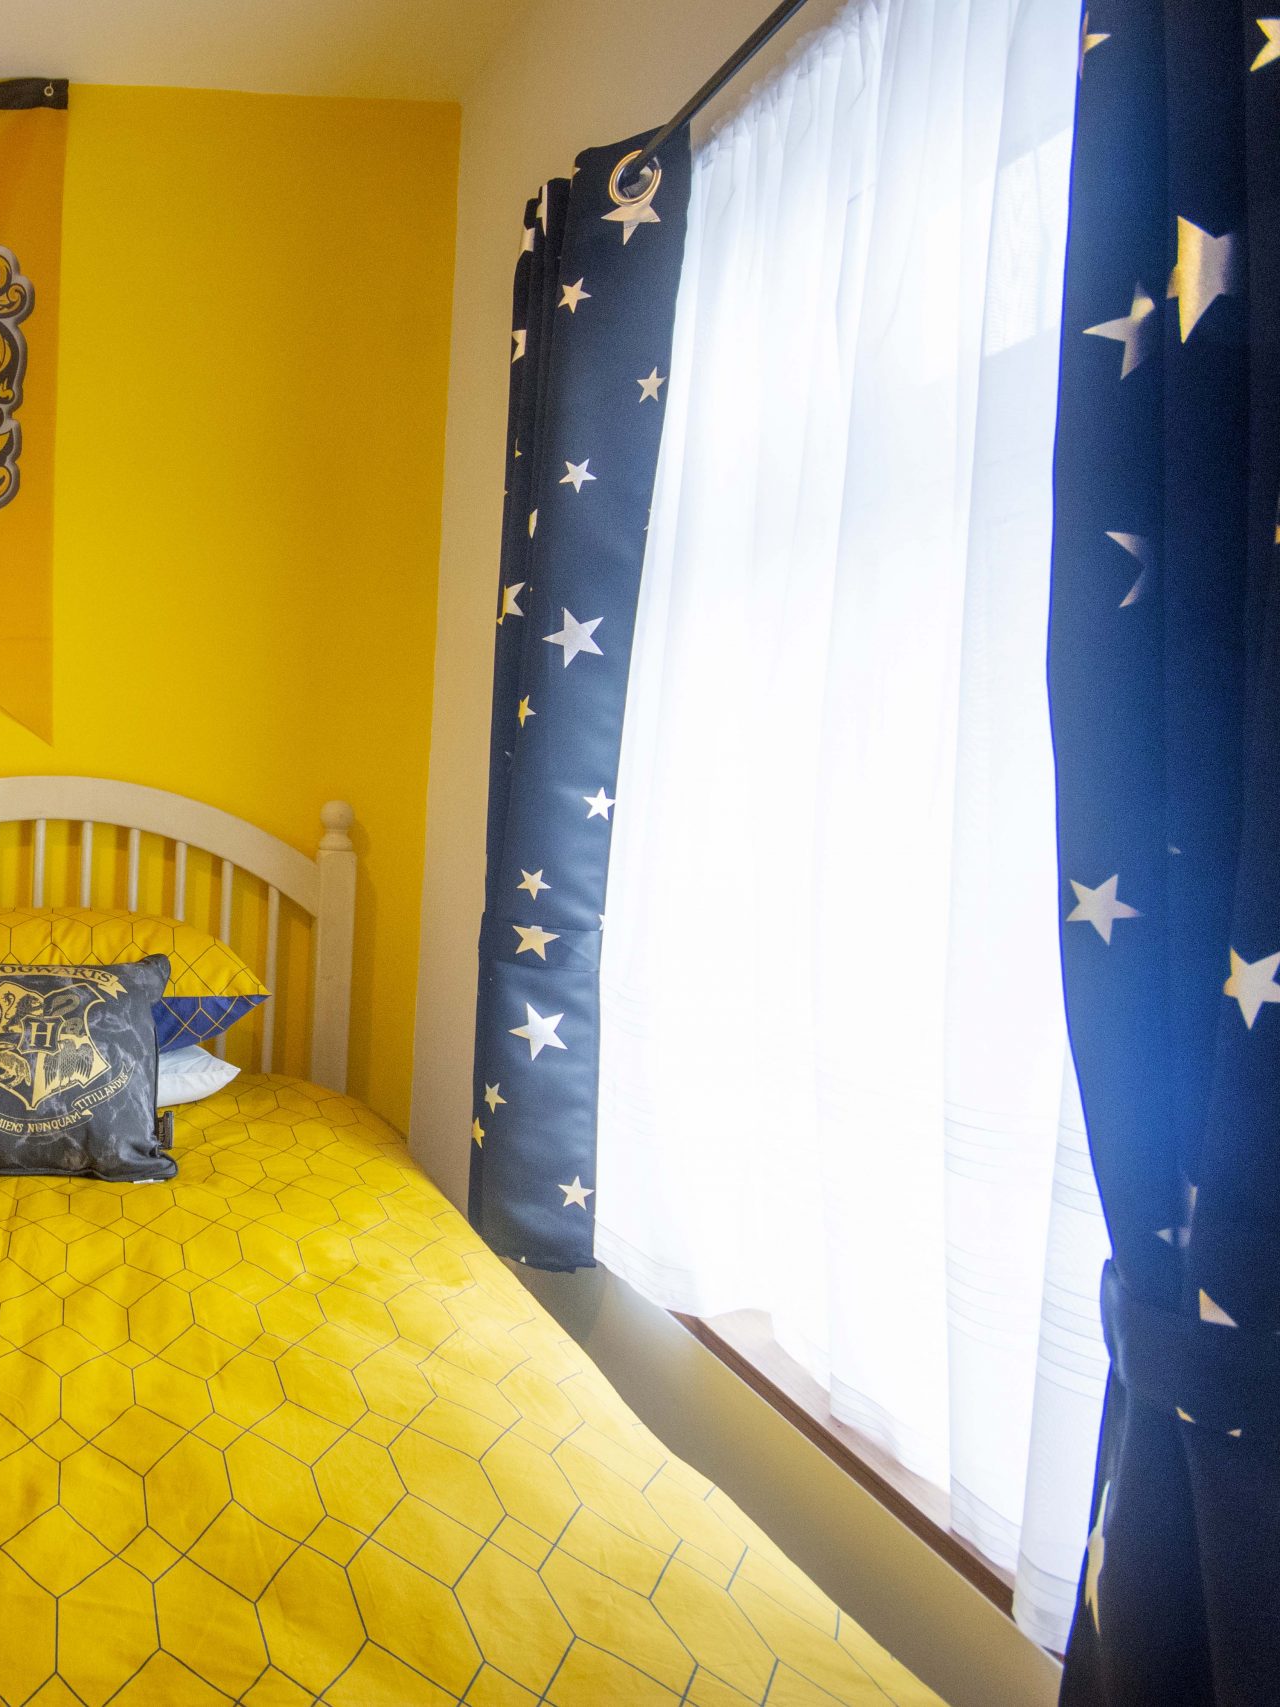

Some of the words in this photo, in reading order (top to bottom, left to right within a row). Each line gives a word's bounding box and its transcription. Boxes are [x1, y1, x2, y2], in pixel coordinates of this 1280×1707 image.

[29, 1022, 53, 1048] H
[27, 1113, 81, 1133] NUNQUAM
[76, 1073, 129, 1110] TITILLANDUS
